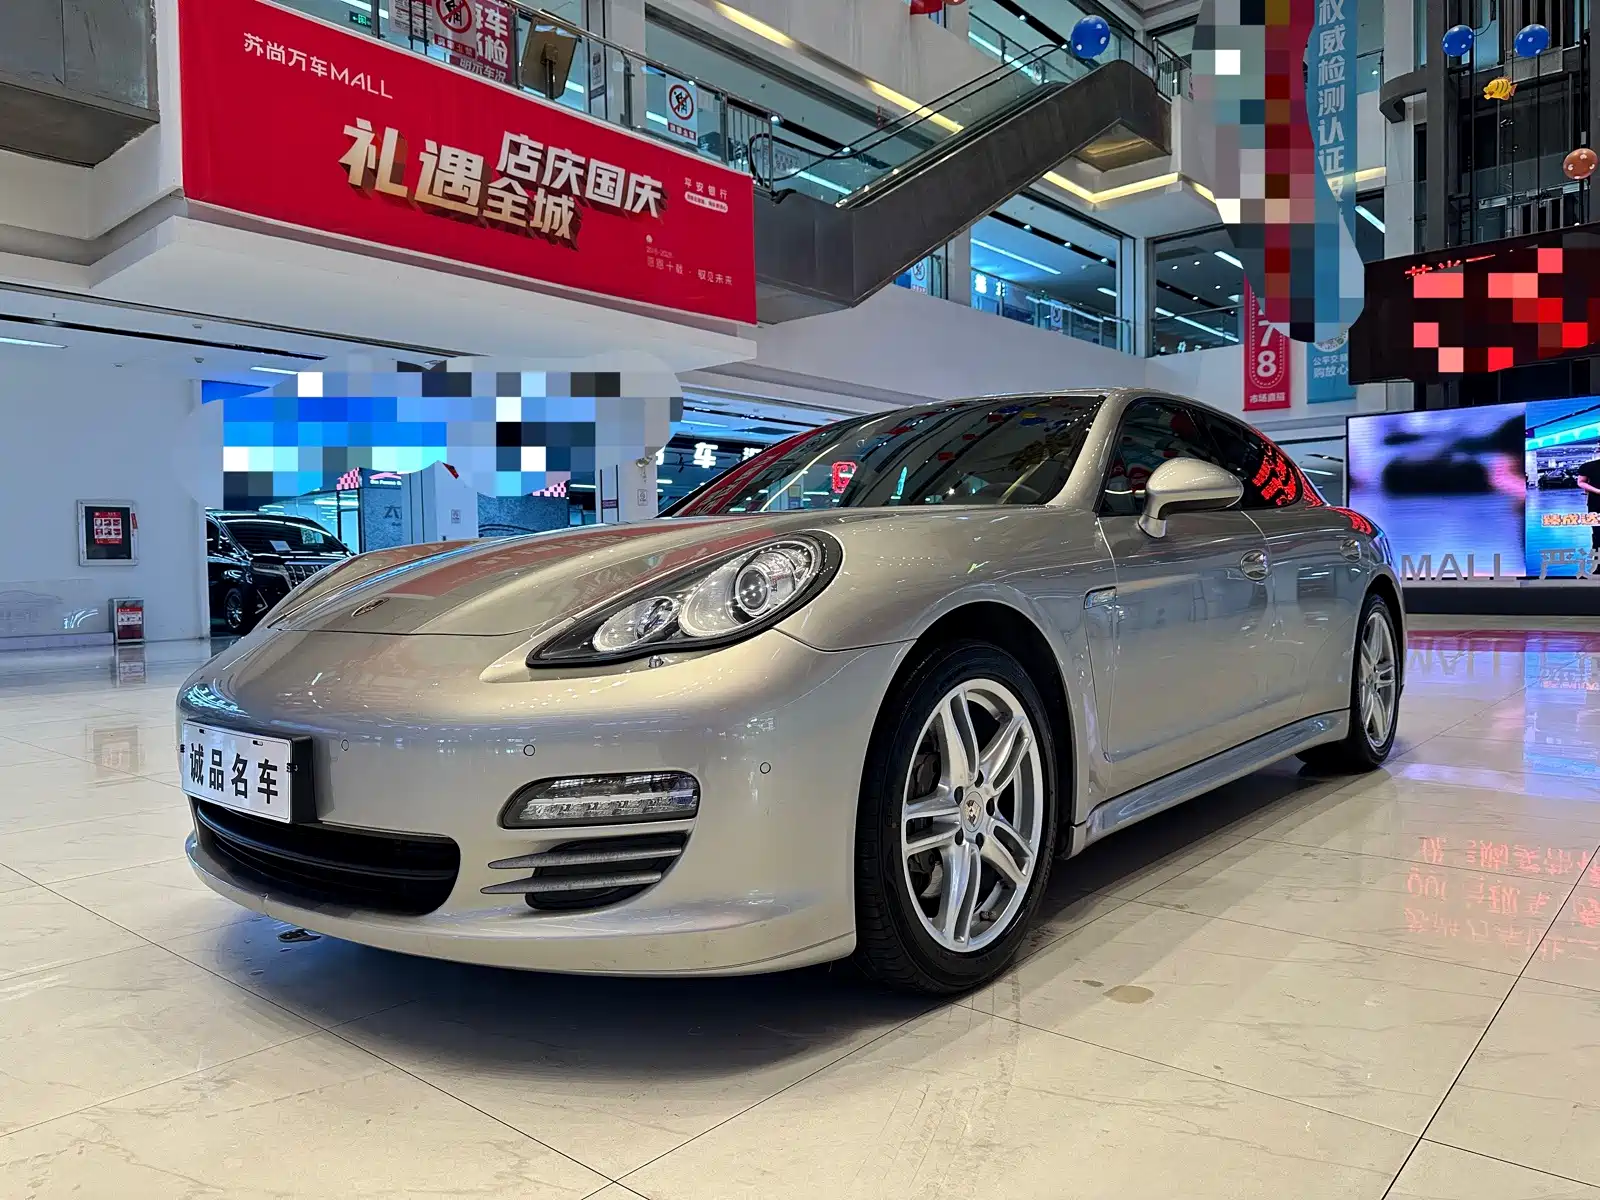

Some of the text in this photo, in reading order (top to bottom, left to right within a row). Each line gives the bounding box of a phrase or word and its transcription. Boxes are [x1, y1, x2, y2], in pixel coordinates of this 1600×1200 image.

[243, 32, 394, 99] 苏尚万车MALL
[495, 130, 663, 218] 店庆国庆
[1401, 553, 1517, 581] MALL
[189, 743, 279, 805] 诚品名车
